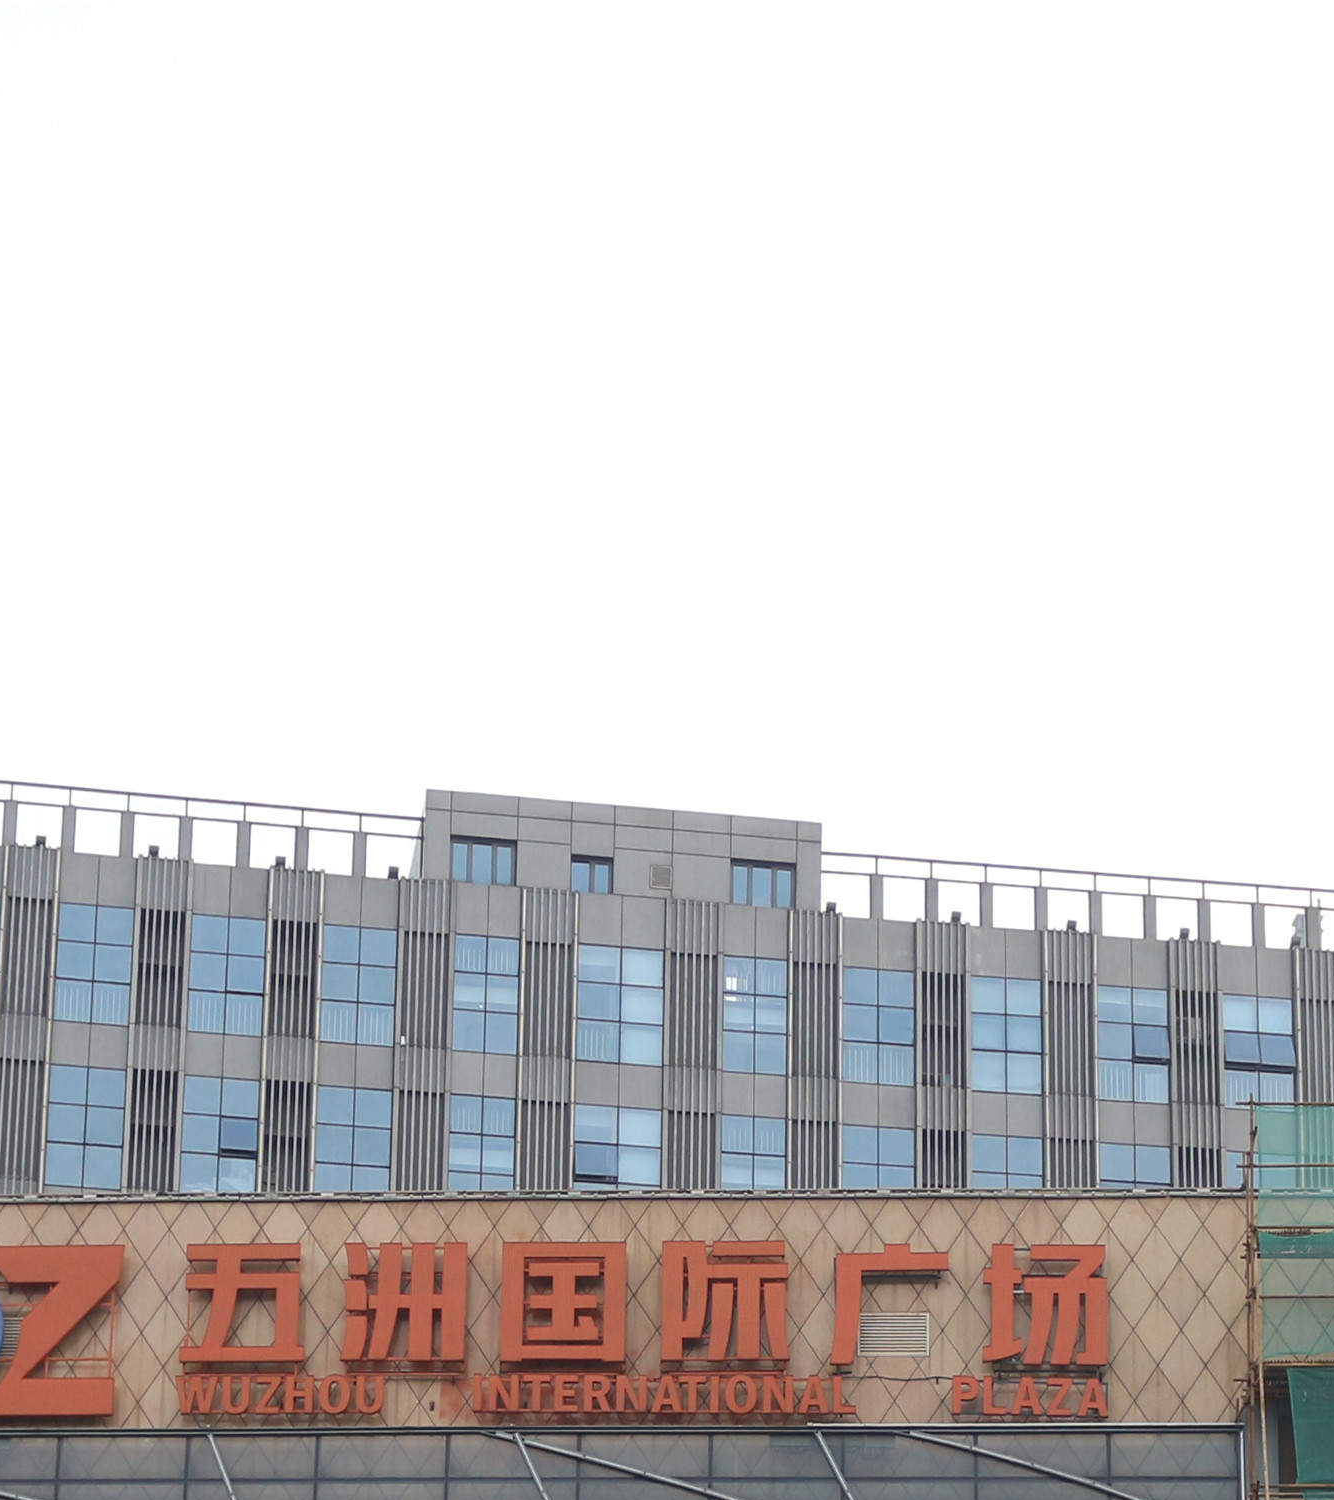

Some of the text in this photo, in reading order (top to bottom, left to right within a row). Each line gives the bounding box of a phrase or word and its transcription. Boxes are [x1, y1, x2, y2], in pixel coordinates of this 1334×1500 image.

[178, 1241, 1109, 1367] 五洲国际广场
[175, 1372, 1109, 1419] WUZHOU INTERNATIONAL PLAZA
